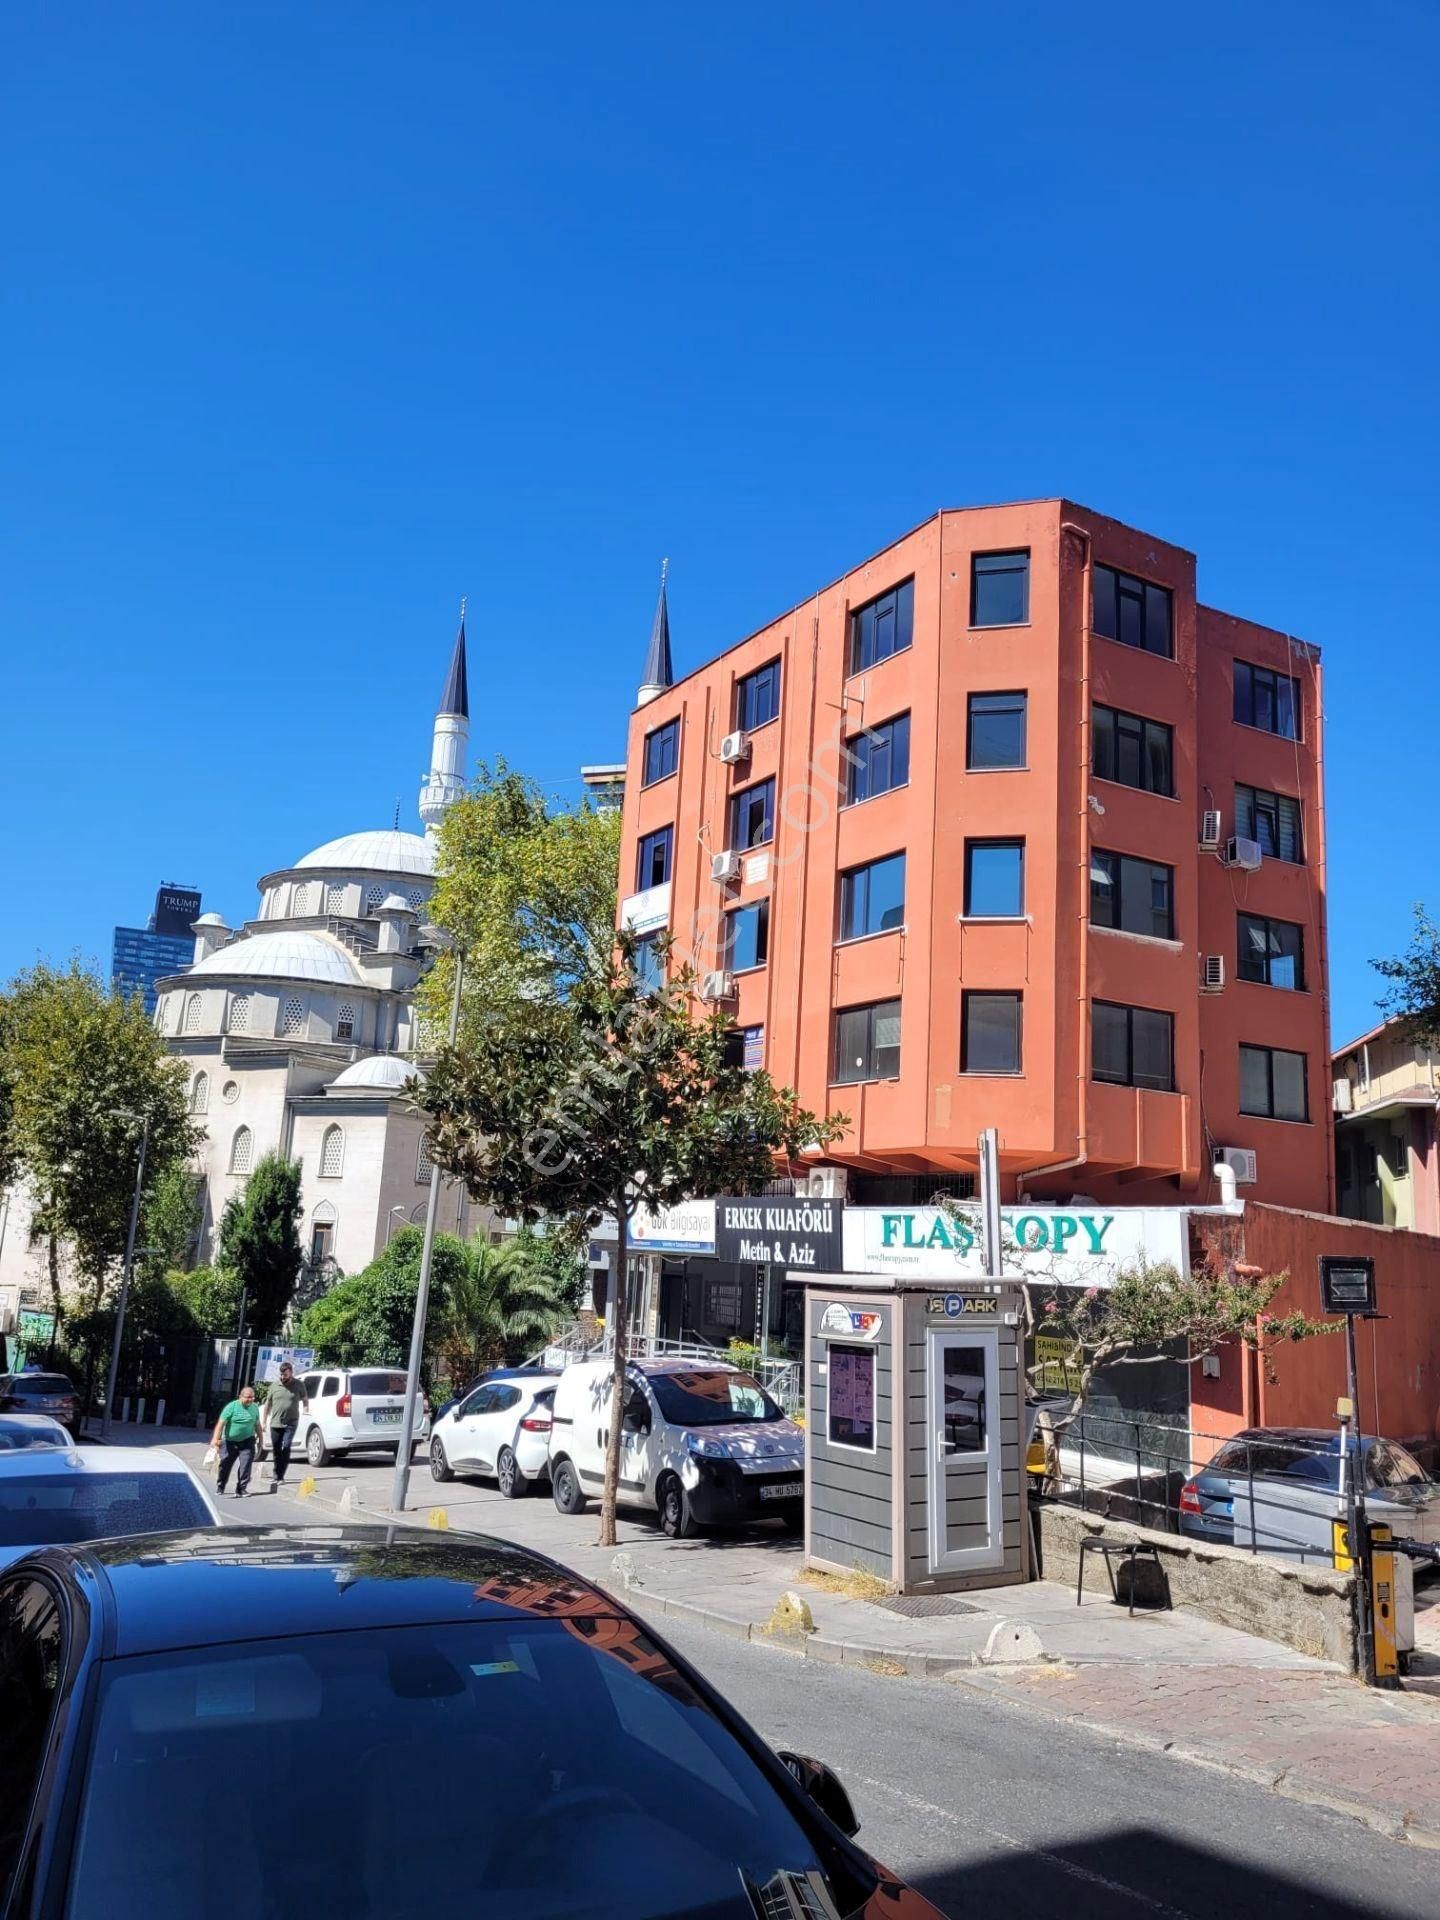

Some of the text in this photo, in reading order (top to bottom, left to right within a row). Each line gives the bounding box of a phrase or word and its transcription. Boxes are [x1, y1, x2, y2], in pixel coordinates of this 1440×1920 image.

[162, 895, 199, 909] TRUMP
[724, 1202, 833, 1233] ERKEK KUAFÖRÜ
[740, 1239, 816, 1265] Metin & Aziz
